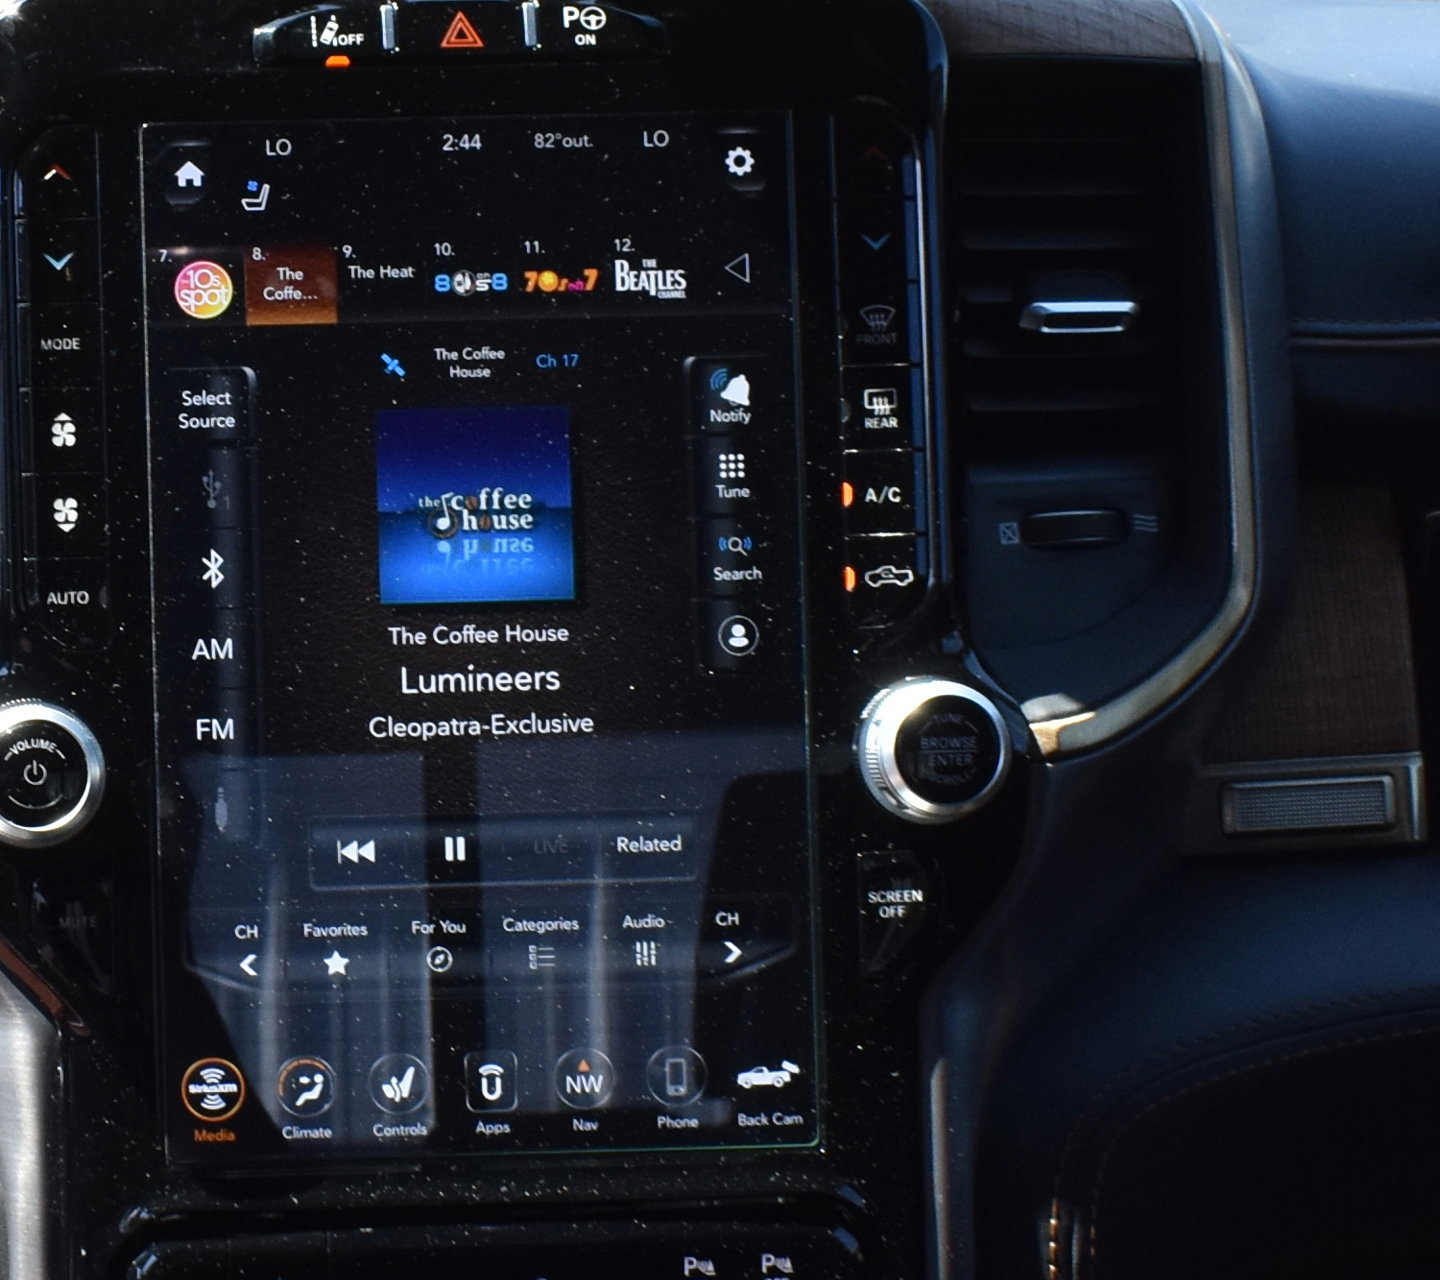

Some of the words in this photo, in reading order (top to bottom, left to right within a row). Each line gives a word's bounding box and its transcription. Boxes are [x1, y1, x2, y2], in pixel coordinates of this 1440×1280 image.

[338, 33, 364, 46] OFF
[575, 33, 597, 46] ON
[442, 134, 482, 152] 2:44
[643, 130, 670, 148] LO
[266, 138, 292, 157] LO
[342, 245, 357, 259] 9.
[434, 242, 456, 256] 10.
[524, 240, 546, 254] 11.
[614, 239, 635, 252] 12.
[158, 249, 173, 263] 7.
[252, 247, 267, 261] 8.
[187, 269, 220, 288] 10s
[276, 267, 304, 281] The
[348, 266, 375, 279] The
[380, 265, 415, 279] Heat
[180, 287, 228, 312] spot
[40, 337, 81, 352] MODE
[434, 348, 459, 361] The
[463, 346, 506, 361] Coffee
[536, 354, 557, 368] Ch
[562, 354, 579, 367] 17
[449, 366, 491, 379] House
[181, 389, 232, 408] Select
[178, 412, 236, 431] Source
[710, 408, 752, 425] Notify
[864, 416, 898, 429] REAR
[715, 484, 751, 498] Tune
[865, 486, 901, 504] A/C
[418, 496, 441, 508] the
[713, 566, 762, 582] Search
[46, 590, 90, 605] AUTO
[388, 626, 426, 646] The
[433, 624, 501, 645] Coffee
[508, 623, 569, 644] House
[191, 638, 234, 661] AM
[400, 665, 561, 695] Lumineers
[195, 718, 235, 741] FM
[369, 712, 594, 741] Cleopatra-Exclusive
[8, 735, 58, 758] VOLUME
[920, 735, 978, 750] BROWSE
[929, 753, 974, 767] ENTER
[616, 835, 682, 853] Related
[868, 889, 924, 907] SCREEN
[715, 911, 739, 927] CH
[878, 904, 908, 919] OFF
[411, 920, 434, 934] For
[438, 919, 467, 935] You
[502, 917, 579, 935] Categories
[622, 914, 665, 929] Audio
[234, 924, 258, 939] CH
[303, 922, 368, 938] Favorites
[565, 1074, 604, 1094] NW
[572, 1117, 599, 1133] Nav
[656, 1114, 699, 1131] Phone
[737, 1112, 764, 1128] Back
[769, 1111, 803, 1127] Cam
[193, 1127, 236, 1144] Media
[281, 1124, 332, 1141] Climate
[372, 1122, 428, 1139] Controls
[475, 1120, 511, 1138] Apps
